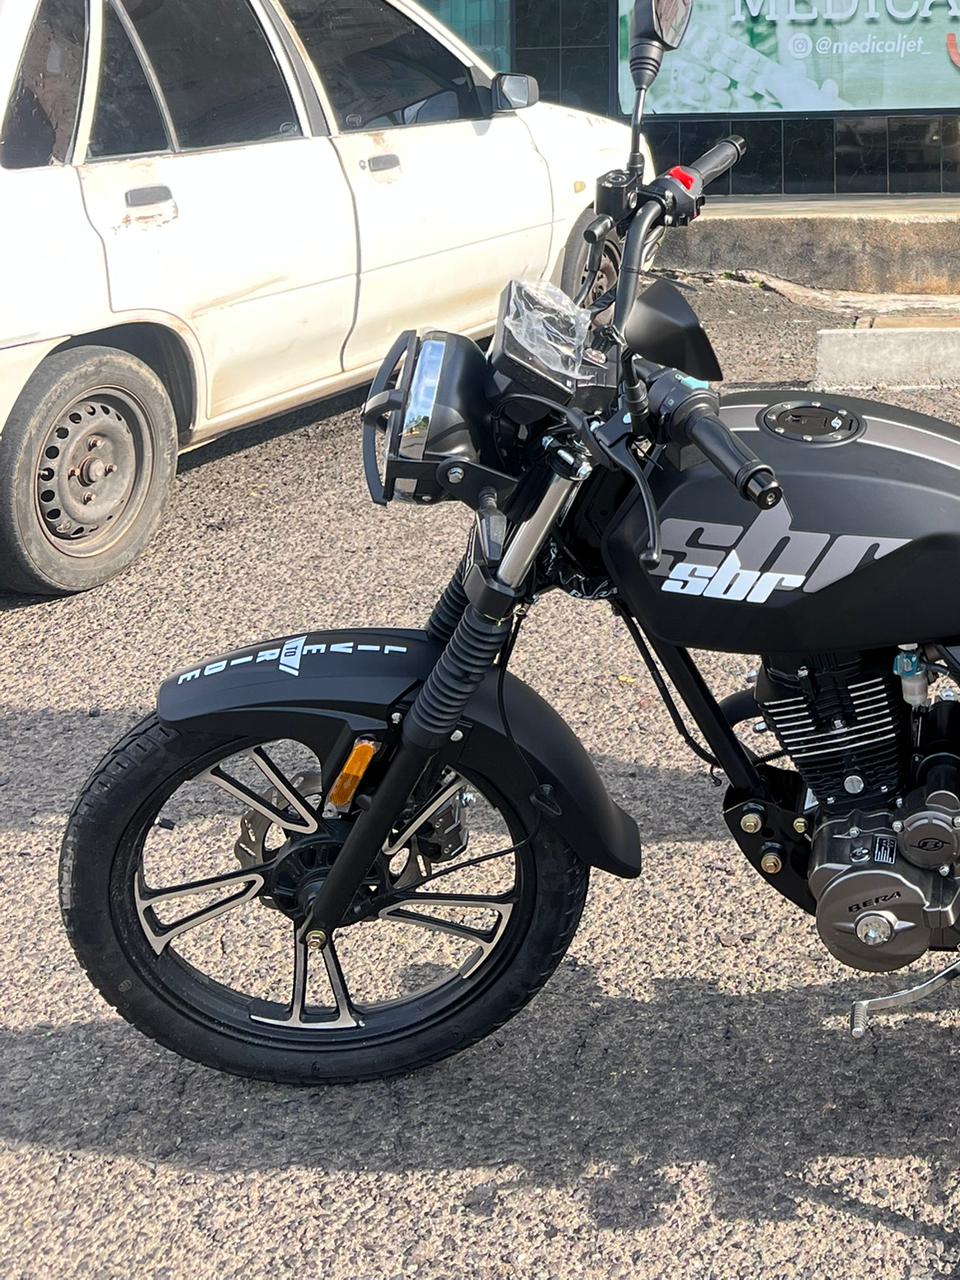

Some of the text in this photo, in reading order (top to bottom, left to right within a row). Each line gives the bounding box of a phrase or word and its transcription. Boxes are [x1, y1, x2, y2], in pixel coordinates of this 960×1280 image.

[815, 33, 932, 58] @medicaljet_
[660, 548, 806, 604] sbr
[847, 890, 902, 913] BERA
